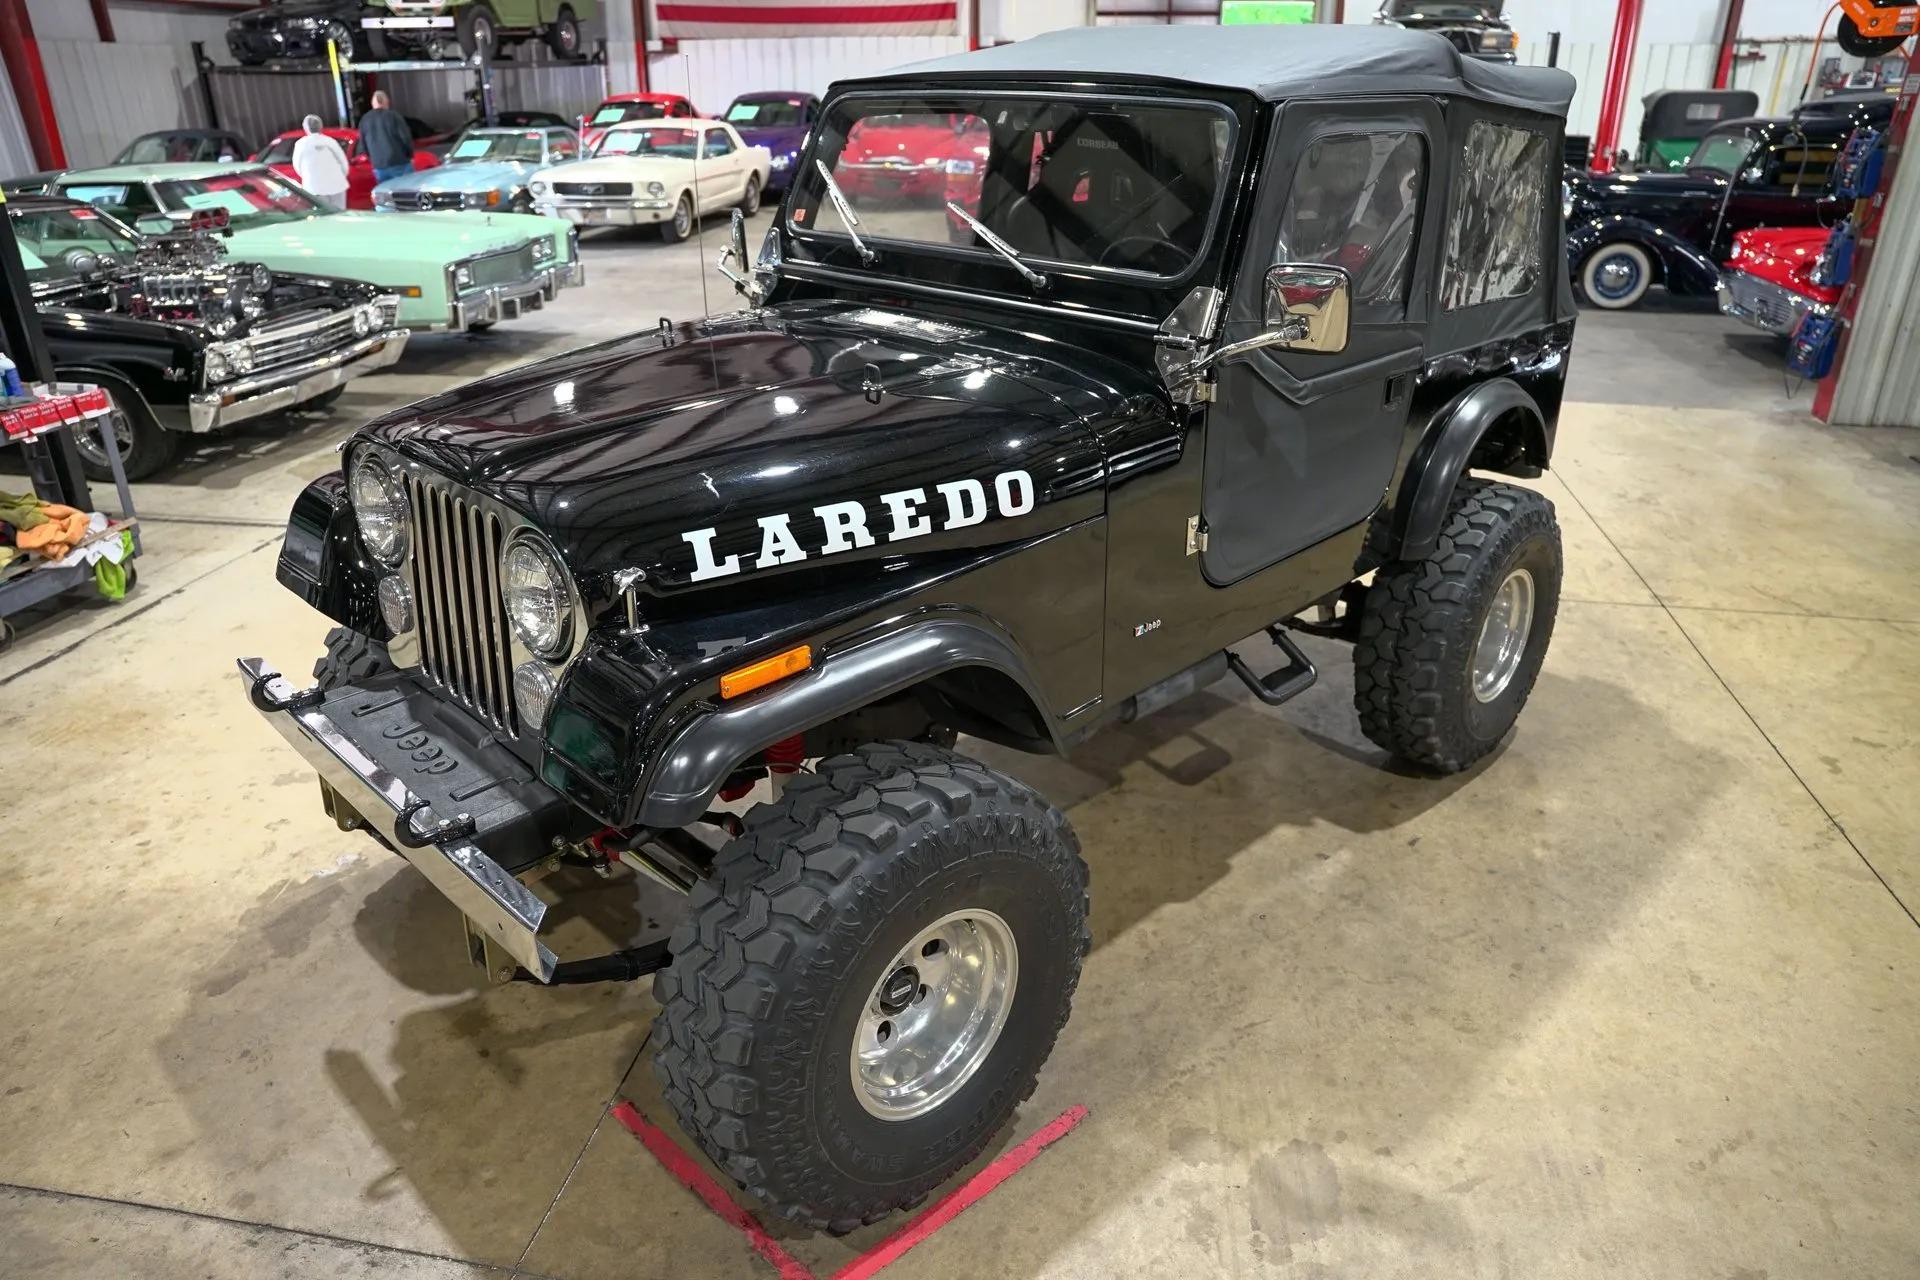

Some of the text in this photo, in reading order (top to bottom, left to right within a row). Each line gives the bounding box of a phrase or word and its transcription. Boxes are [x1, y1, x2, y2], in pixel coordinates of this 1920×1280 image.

[681, 469, 1035, 582] LAREDO
[1144, 619, 1162, 633] Jeep
[382, 721, 459, 775] Jeep
